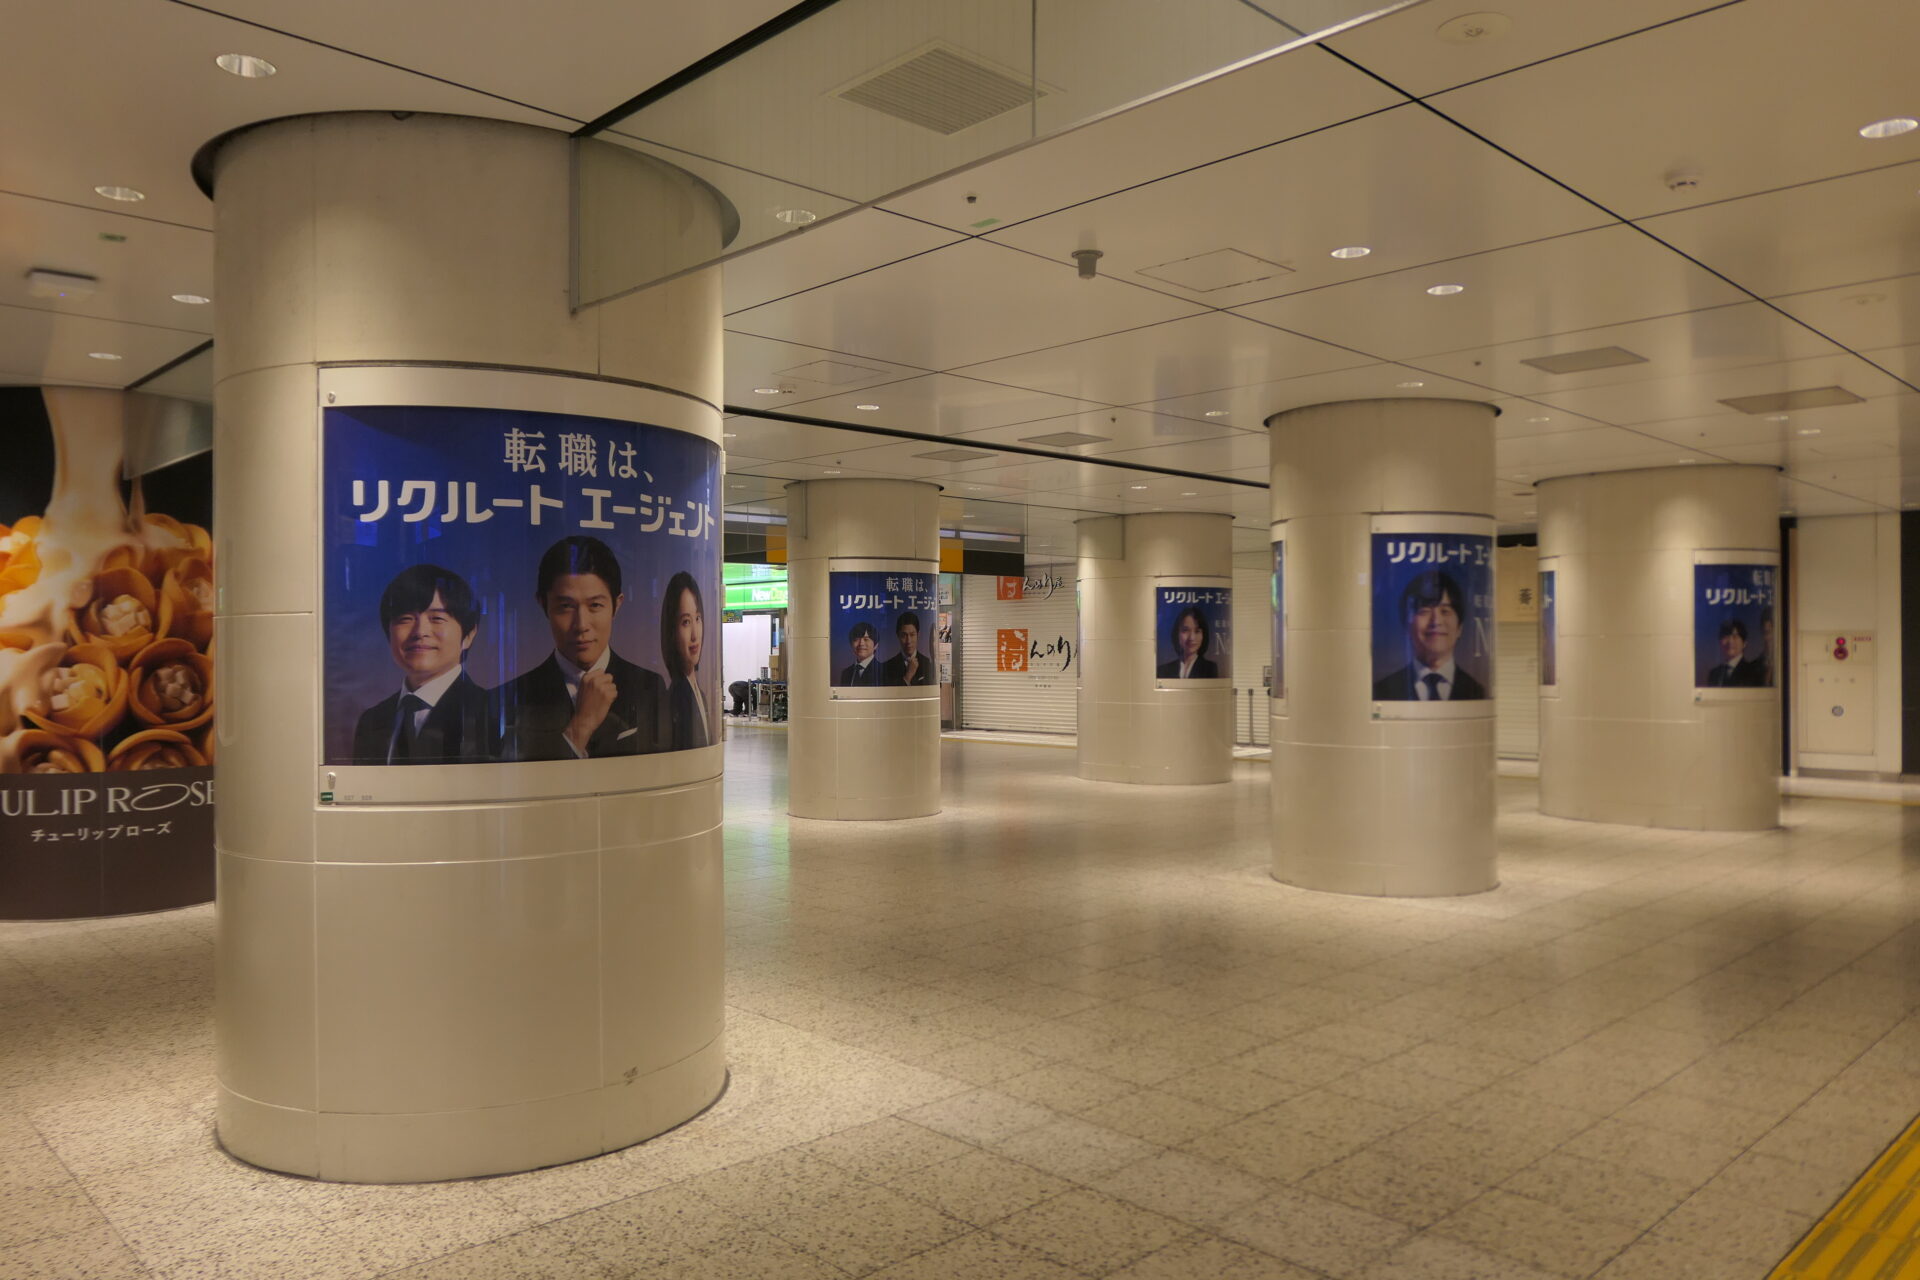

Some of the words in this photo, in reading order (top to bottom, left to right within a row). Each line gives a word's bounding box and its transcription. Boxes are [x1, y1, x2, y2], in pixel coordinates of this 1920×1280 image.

[503, 427, 654, 484] 転職は、
[352, 479, 564, 526] リクルート
[579, 487, 715, 541] エージェント
[1386, 541, 1473, 564] リクルート
[885, 576, 929, 593] 転職は、
[839, 594, 904, 610] リクルート
[1164, 591, 1214, 604] リクルート
[1705, 587, 1767, 606] リクルート
[0, 788, 97, 817] ULIP
[30, 821, 172, 843] チューリップローズ
